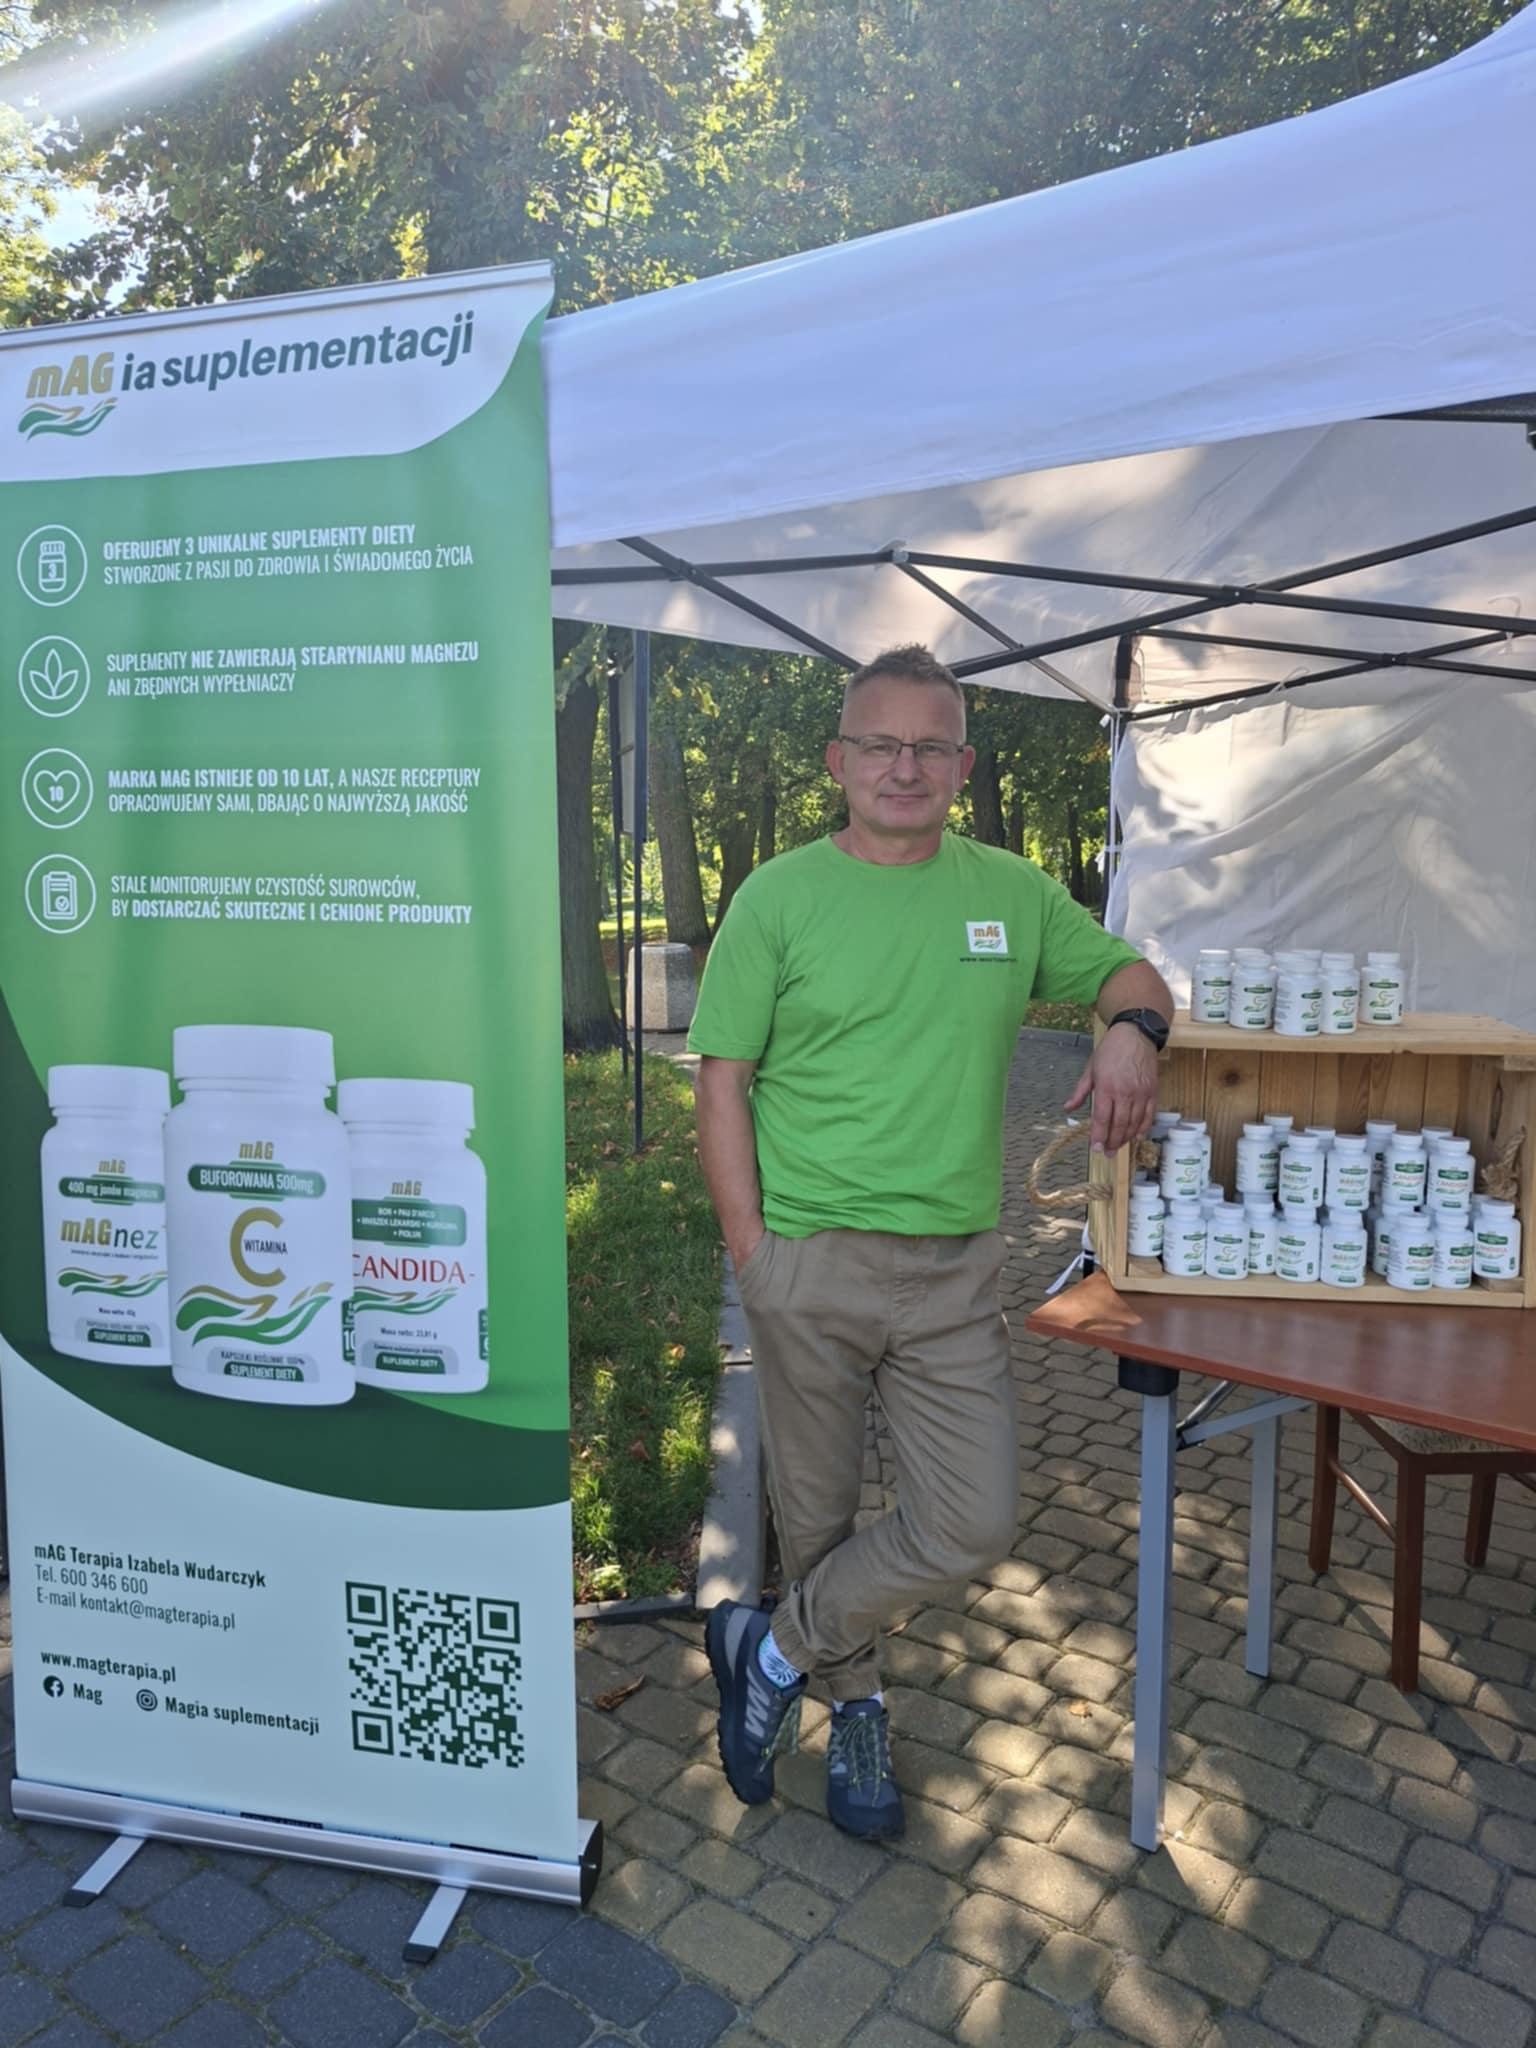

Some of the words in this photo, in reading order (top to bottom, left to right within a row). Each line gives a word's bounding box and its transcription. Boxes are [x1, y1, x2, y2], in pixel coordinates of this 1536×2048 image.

[162, 310, 474, 391] suplementacji
[103, 537, 182, 560] OFERUJEMY
[185, 537, 194, 555] 3
[198, 532, 268, 554] UNIKALNE
[271, 526, 367, 549] SUPLEMENTY
[372, 524, 415, 545] DIETY
[104, 562, 182, 585] STWORZONE
[185, 562, 192, 580] Z
[196, 559, 230, 580] PASJI
[234, 558, 253, 577] DO
[257, 554, 320, 576] ZDROWIA
[325, 554, 329, 572] I
[334, 548, 432, 572] ŚWIADOMEGO
[436, 544, 473, 568] ŻYCIA
[107, 651, 187, 672] SUPLEMENTY
[191, 650, 214, 669] NIE
[217, 647, 297, 671] ZAWIERAJĄ
[301, 644, 405, 665] STEARYNIANU
[411, 641, 478, 664] MAGNEZU
[107, 678, 130, 696] ANI
[134, 675, 199, 700] ZBĘDNYCH
[203, 672, 295, 693] WYPEŁNIACZY
[108, 770, 157, 788] MARKA
[160, 769, 190, 788] MAG
[194, 769, 253, 787] ISTNIEJE
[257, 769, 278, 787] OD
[282, 769, 299, 787] 10
[304, 768, 334, 789] LAT,
[338, 768, 348, 786] A
[352, 768, 397, 787] NASZE
[401, 768, 481, 787] RECEPTURY
[108, 793, 213, 812] OPRACOWUJEMY
[217, 793, 254, 813] SAMI,
[258, 793, 309, 816] DBAJĄC
[313, 793, 323, 812] O
[328, 789, 411, 817] NAJWYŻSZĄ
[414, 788, 468, 813] JAKOŚĆ
[111, 876, 147, 893] STALE
[150, 876, 251, 895] MONITORUJEMY
[255, 874, 325, 896] CZYSTOŚĆ
[329, 874, 420, 900] SUROWCÓW,
[112, 899, 129, 917] BY
[132, 896, 221, 919] DOSTARCZAĆ
[225, 901, 306, 920] SKUTECZNE
[310, 903, 315, 920] I
[320, 903, 384, 922] CENIONE
[388, 904, 472, 924] PRODUKTY
[239, 1141, 274, 1160] mAG
[98, 1159, 126, 1174] mAG
[200, 1168, 275, 1190] BUFOROWANA
[391, 1180, 422, 1196] mAG
[60, 1217, 159, 1250] mAGnez
[230, 1206, 287, 1288] C
[244, 1239, 288, 1255] WITAMINA
[34, 1544, 66, 1562] mAG
[70, 1547, 123, 1571] Terapia
[128, 1554, 180, 1577] Izabela
[184, 1561, 266, 1589] Wudarczyk
[36, 1565, 57, 1583] Tel.
[60, 1568, 87, 1587] 600
[91, 1571, 117, 1590] 346
[121, 1575, 148, 1595] 600
[37, 1587, 77, 1608] E-mail
[80, 1593, 236, 1632] kontakt@magterapia.pl
[41, 1651, 176, 1684] www.magterapia.pl
[73, 1682, 103, 1705] Mag
[165, 1696, 209, 1719] Magia
[213, 1706, 320, 1736] suplementacji
